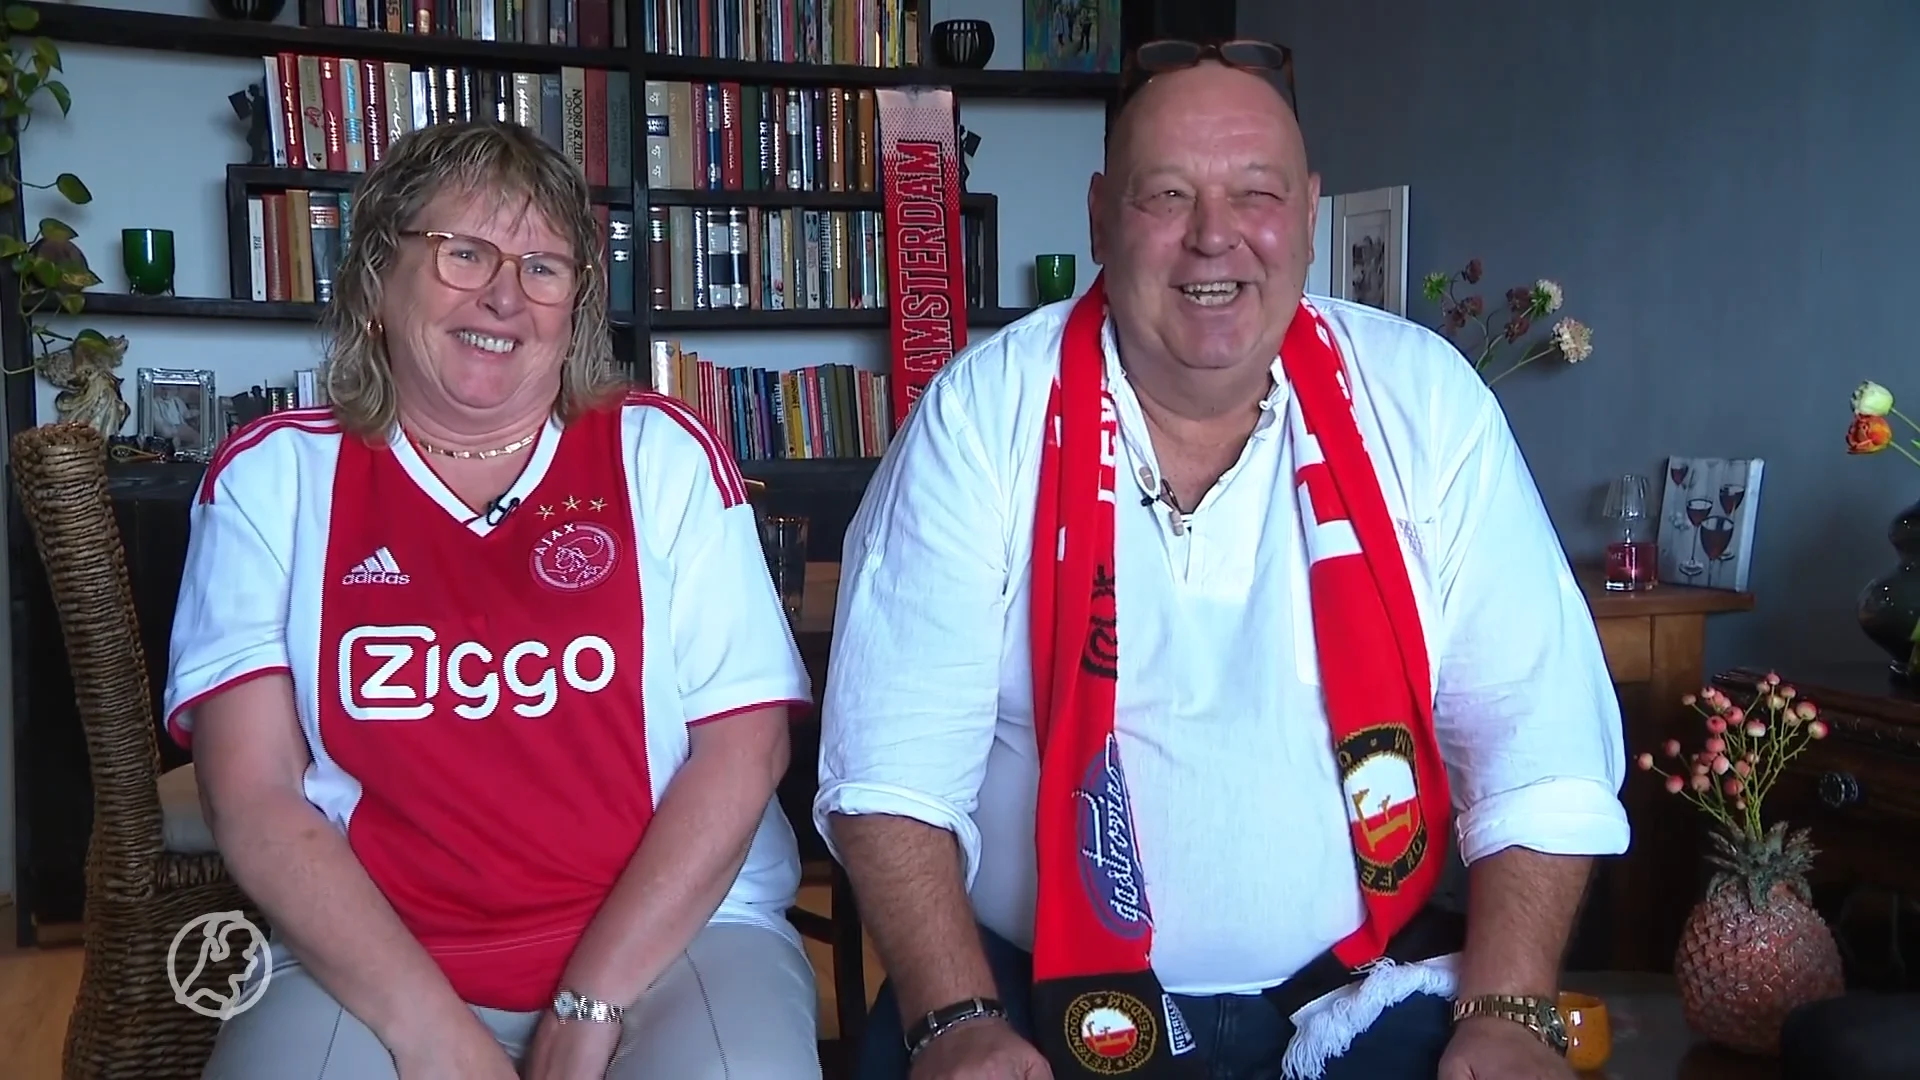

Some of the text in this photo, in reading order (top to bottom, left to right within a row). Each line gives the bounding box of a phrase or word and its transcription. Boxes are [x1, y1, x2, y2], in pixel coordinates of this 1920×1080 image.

[564, 94, 573, 124] JOHN
[572, 88, 583, 128] NOORD
[896, 140, 952, 372] AMSTERDAM
[534, 522, 576, 556] AJAX
[341, 570, 411, 586] adidas
